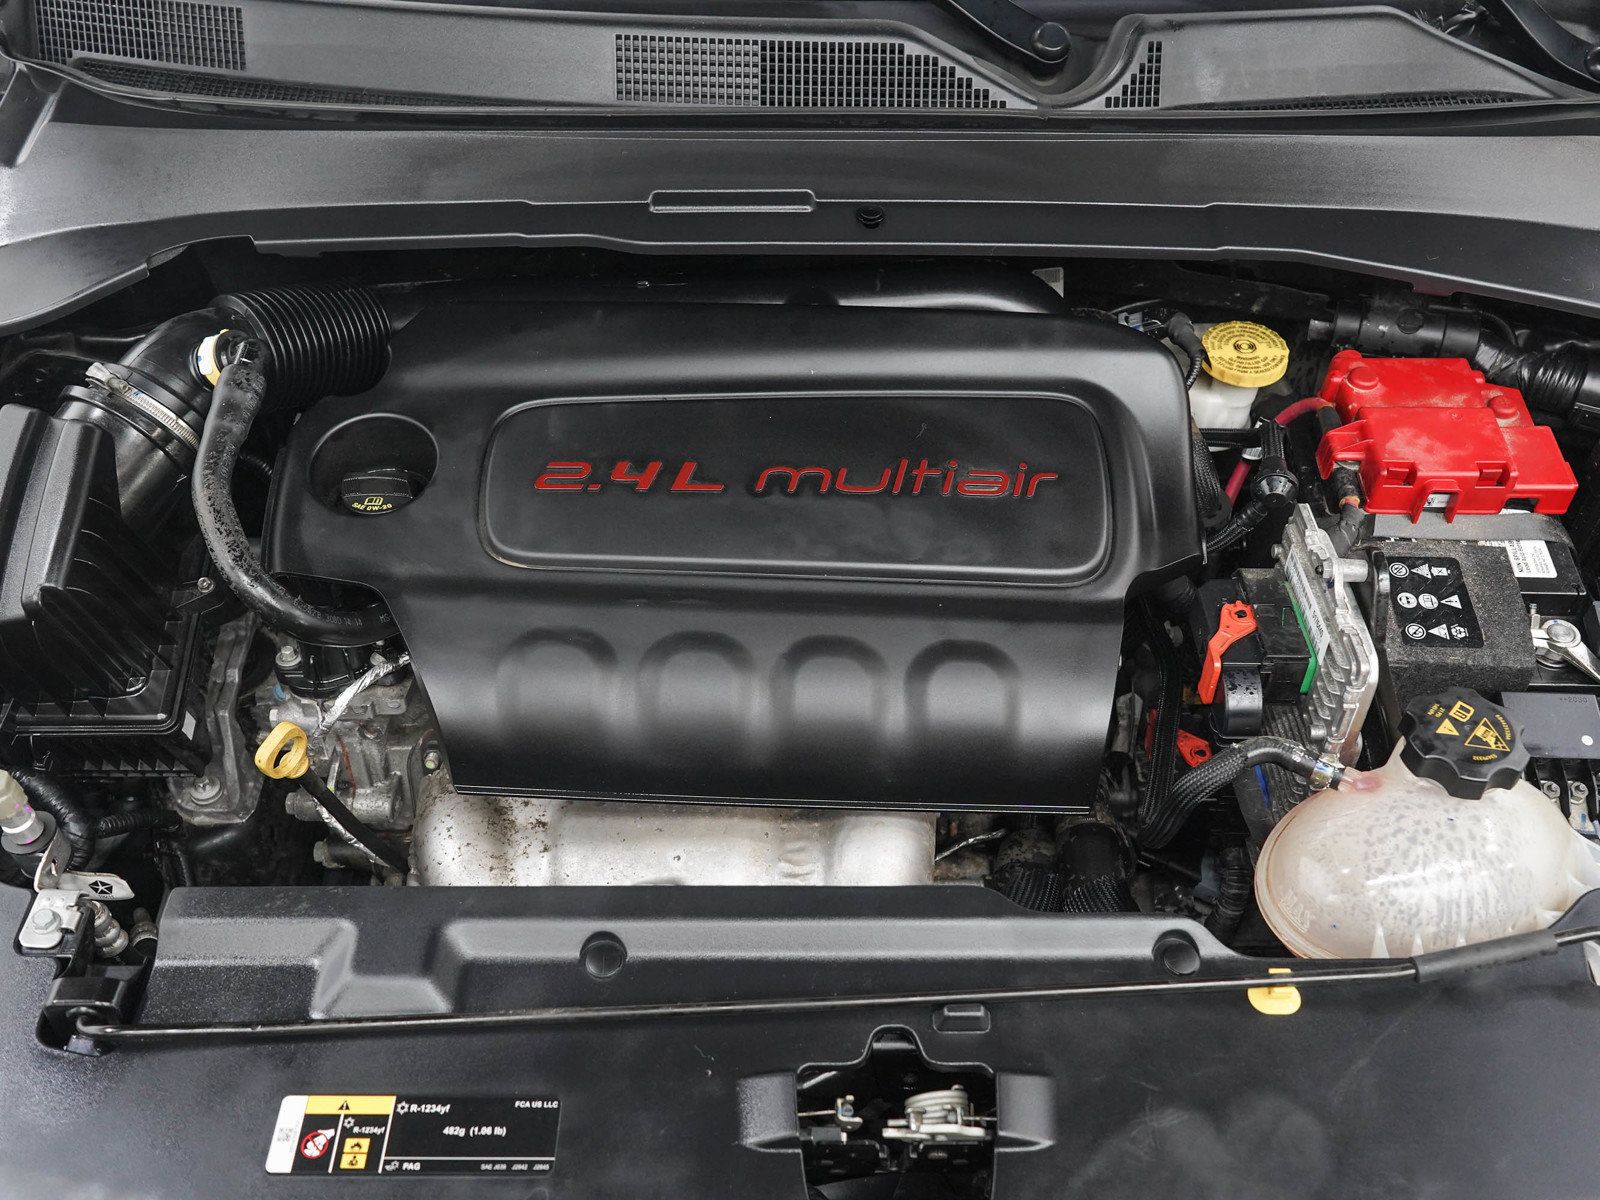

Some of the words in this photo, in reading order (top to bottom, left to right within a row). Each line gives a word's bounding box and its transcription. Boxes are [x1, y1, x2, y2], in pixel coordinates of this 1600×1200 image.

[534, 460, 725, 492] 2.4L
[755, 457, 1058, 497] multiair
[351, 502, 365, 510] SAE
[366, 503, 393, 511] 0W-20
[409, 1103, 451, 1115] R-1234yf
[514, 1100, 531, 1109] FCA
[531, 1100, 542, 1109] US
[543, 1100, 559, 1109] LLC
[352, 1126, 385, 1136] R-1234yf
[493, 1126, 507, 1138] lb)
[402, 1162, 421, 1171] PAG
